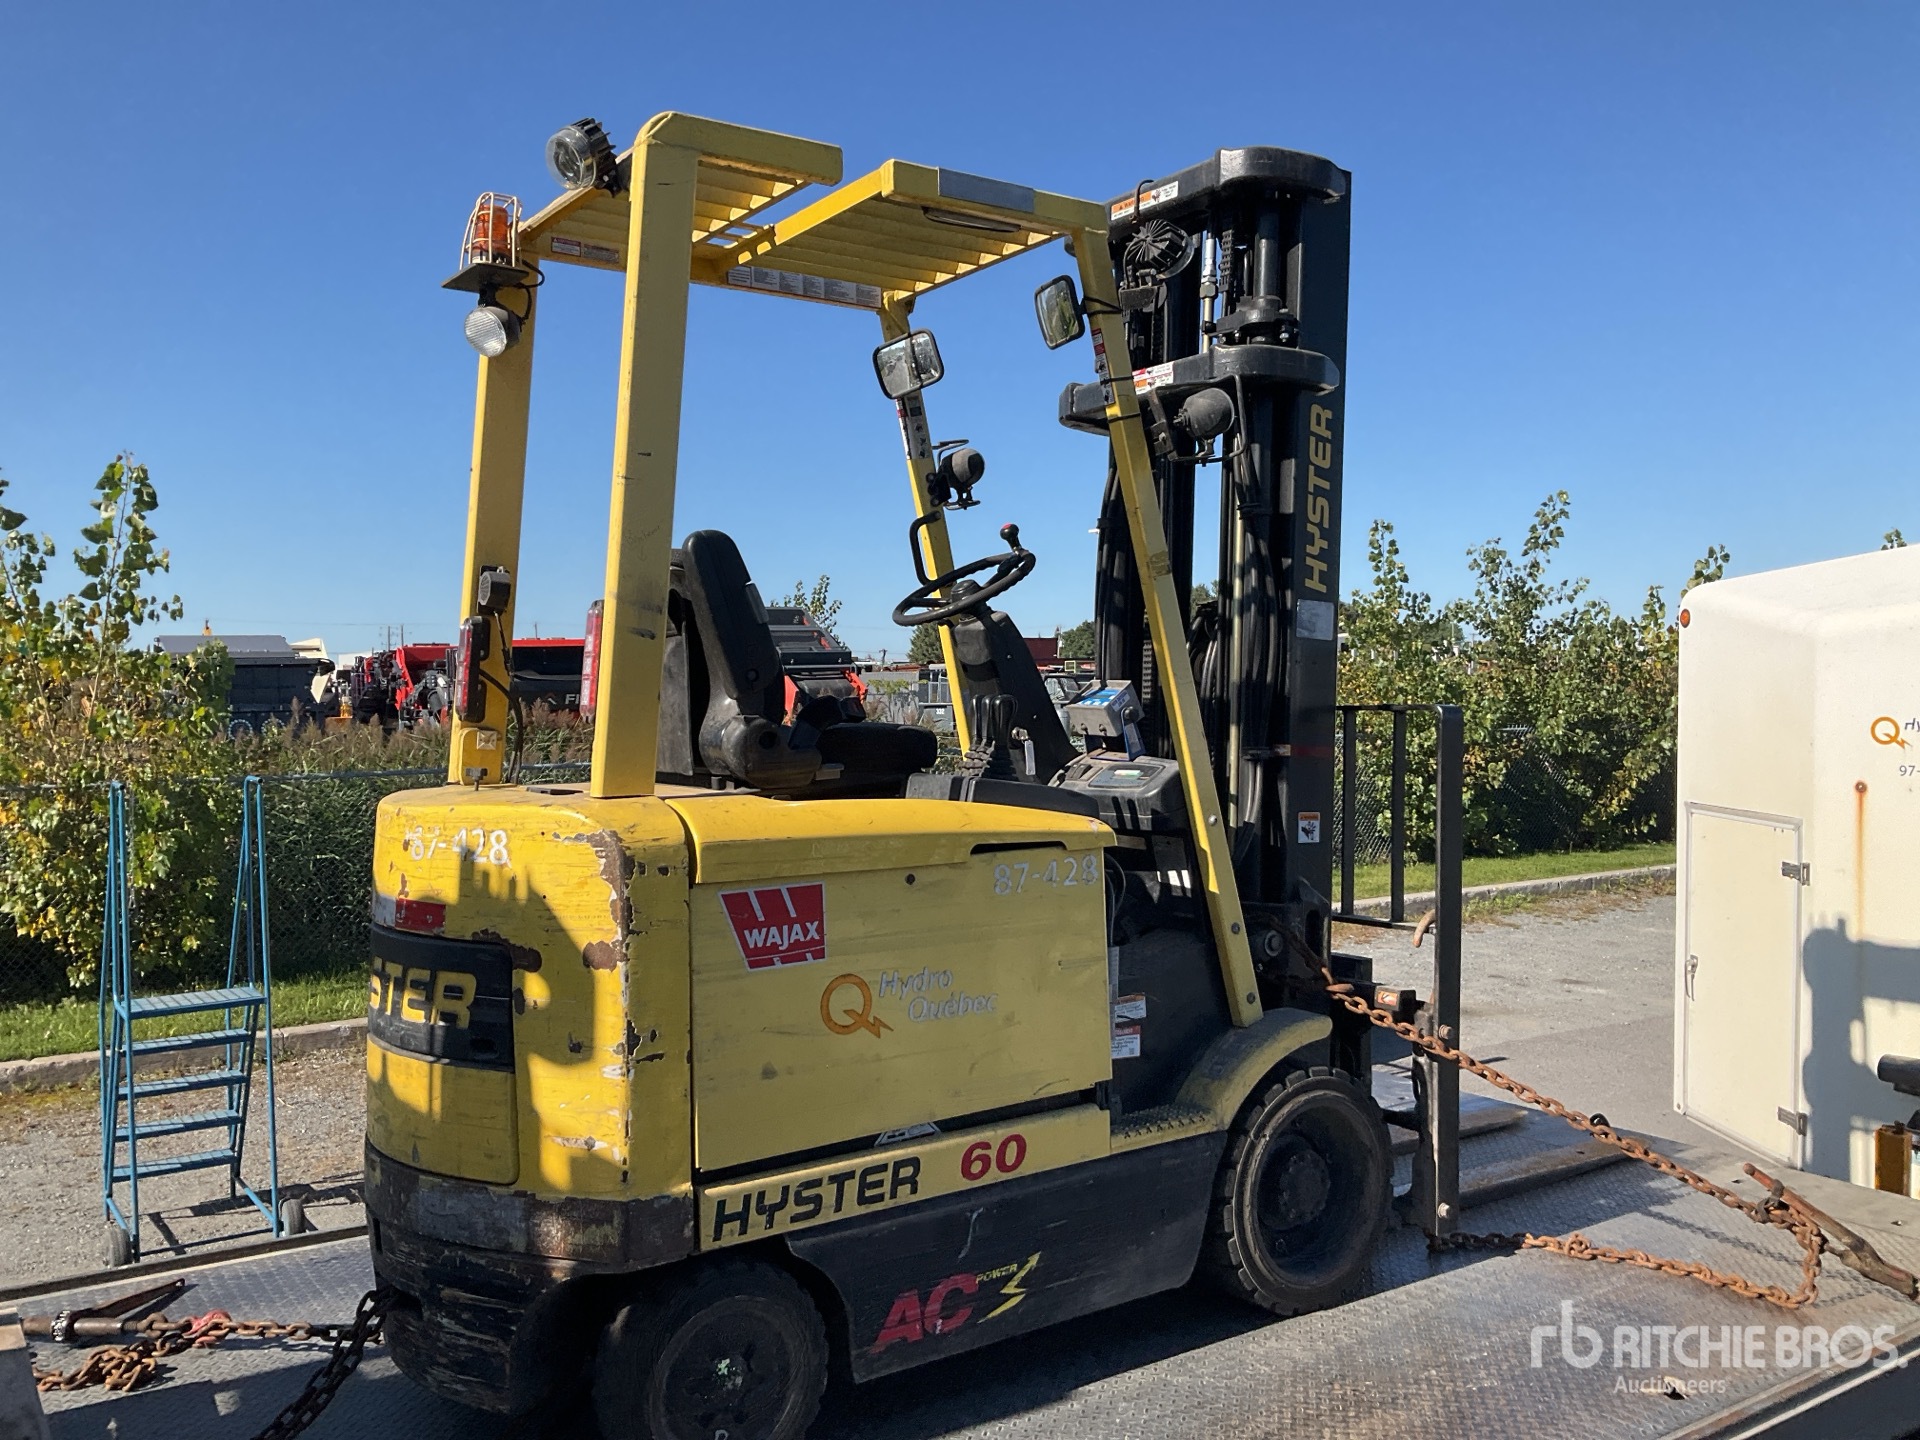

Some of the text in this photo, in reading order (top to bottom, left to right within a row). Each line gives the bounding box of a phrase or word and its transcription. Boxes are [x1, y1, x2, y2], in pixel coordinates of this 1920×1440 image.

[1304, 402, 1334, 594] HYSTER
[994, 853, 1099, 896] 87-428
[743, 920, 821, 951] WAJAX
[879, 966, 953, 1000] Hydro
[711, 1133, 1028, 1243] HYSTER 60
[975, 1263, 1018, 1285] POWER
[871, 1272, 979, 1355] AC
